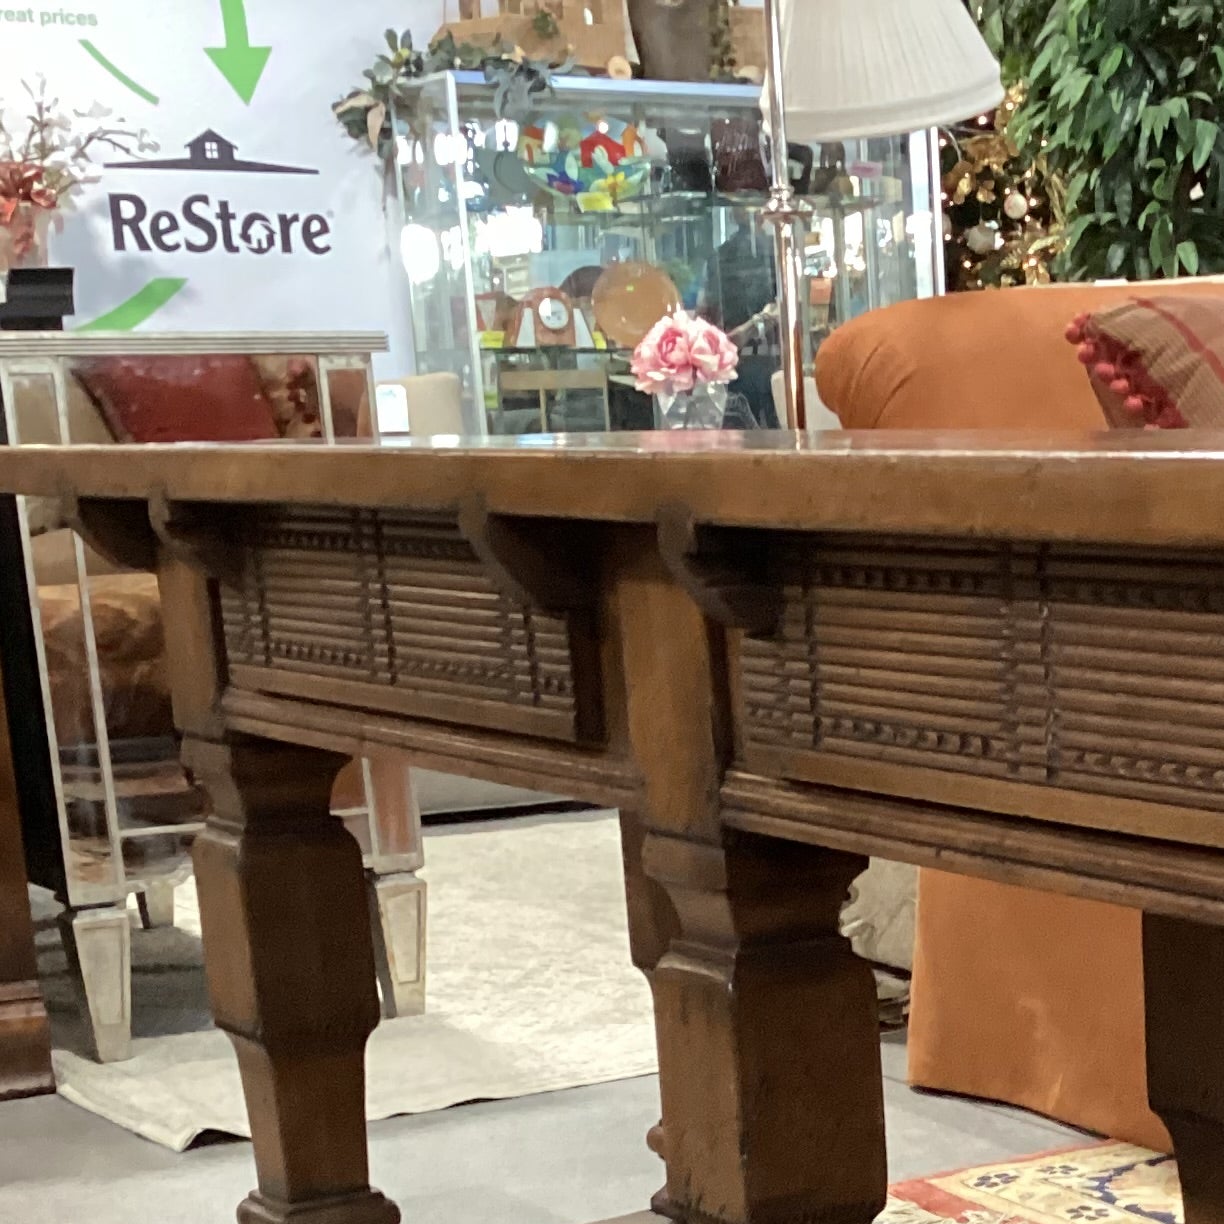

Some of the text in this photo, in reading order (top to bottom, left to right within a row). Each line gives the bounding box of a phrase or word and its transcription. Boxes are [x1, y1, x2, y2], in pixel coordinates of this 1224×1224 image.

[0, 8, 98, 27] reat prices
[108, 193, 331, 255] ReStore
